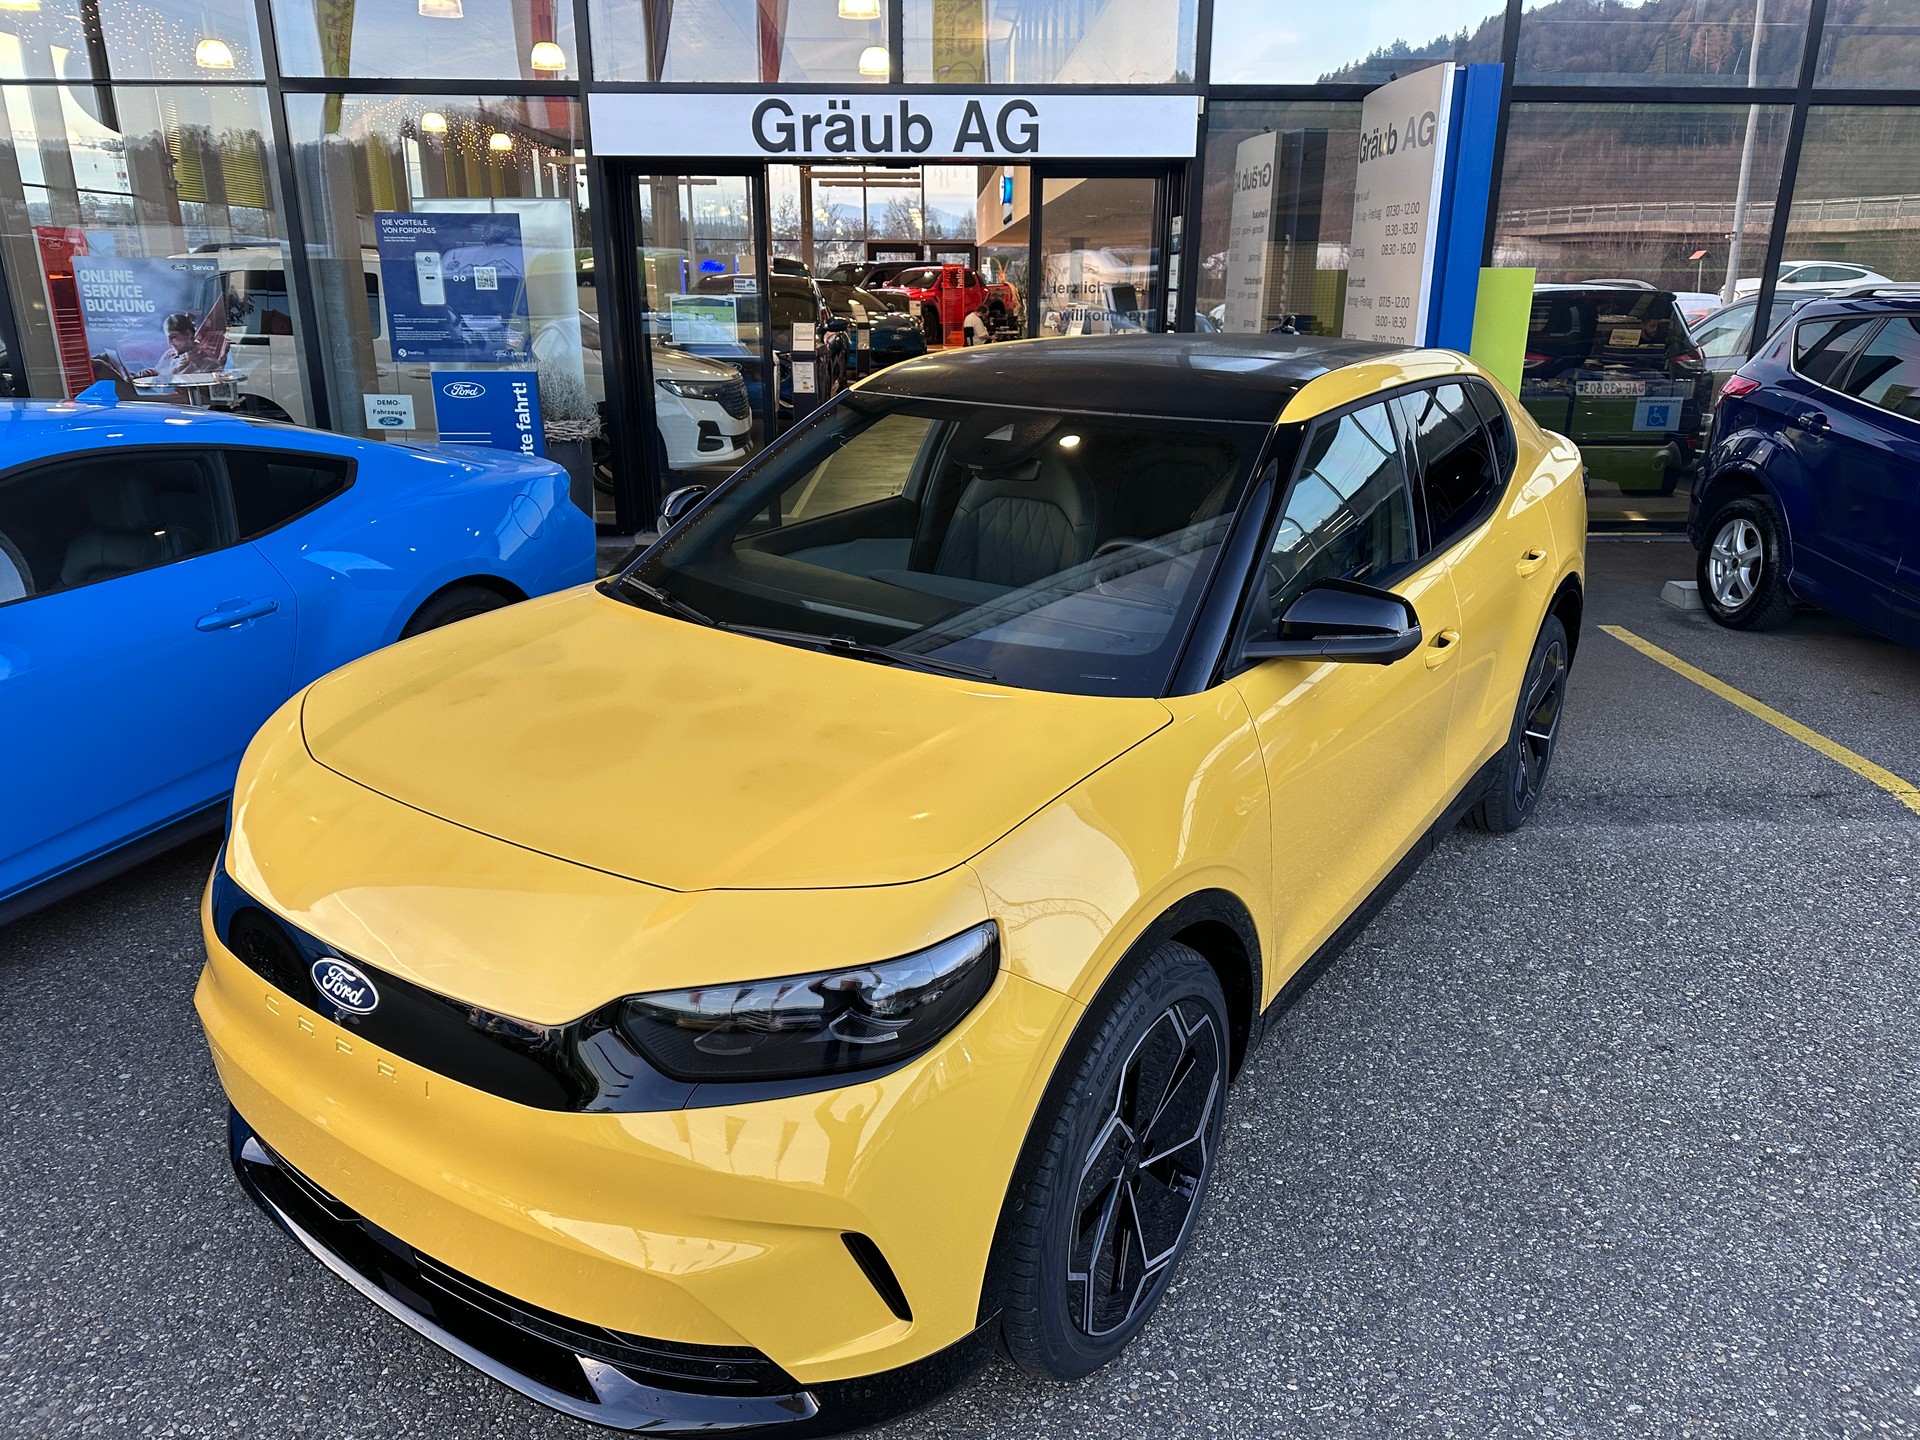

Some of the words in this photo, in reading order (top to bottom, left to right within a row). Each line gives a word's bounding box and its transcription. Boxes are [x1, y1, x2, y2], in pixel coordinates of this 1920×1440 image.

[751, 98, 934, 154] Gräub
[953, 99, 1040, 153] AG
[1360, 122, 1398, 164] Gräub
[1402, 111, 1436, 151] AG
[1404, 202, 1420, 215] 12.00
[381, 218, 393, 226] DIE
[192, 263, 215, 271] Service
[80, 269, 135, 283] ONLINE
[84, 284, 143, 298] SERVICE
[86, 299, 155, 313] BUCHUNG
[511, 382, 531, 431] fahrt!
[265, 993, 430, 1099] CAPRI
[1096, 1020, 1136, 1087] EcoContact
